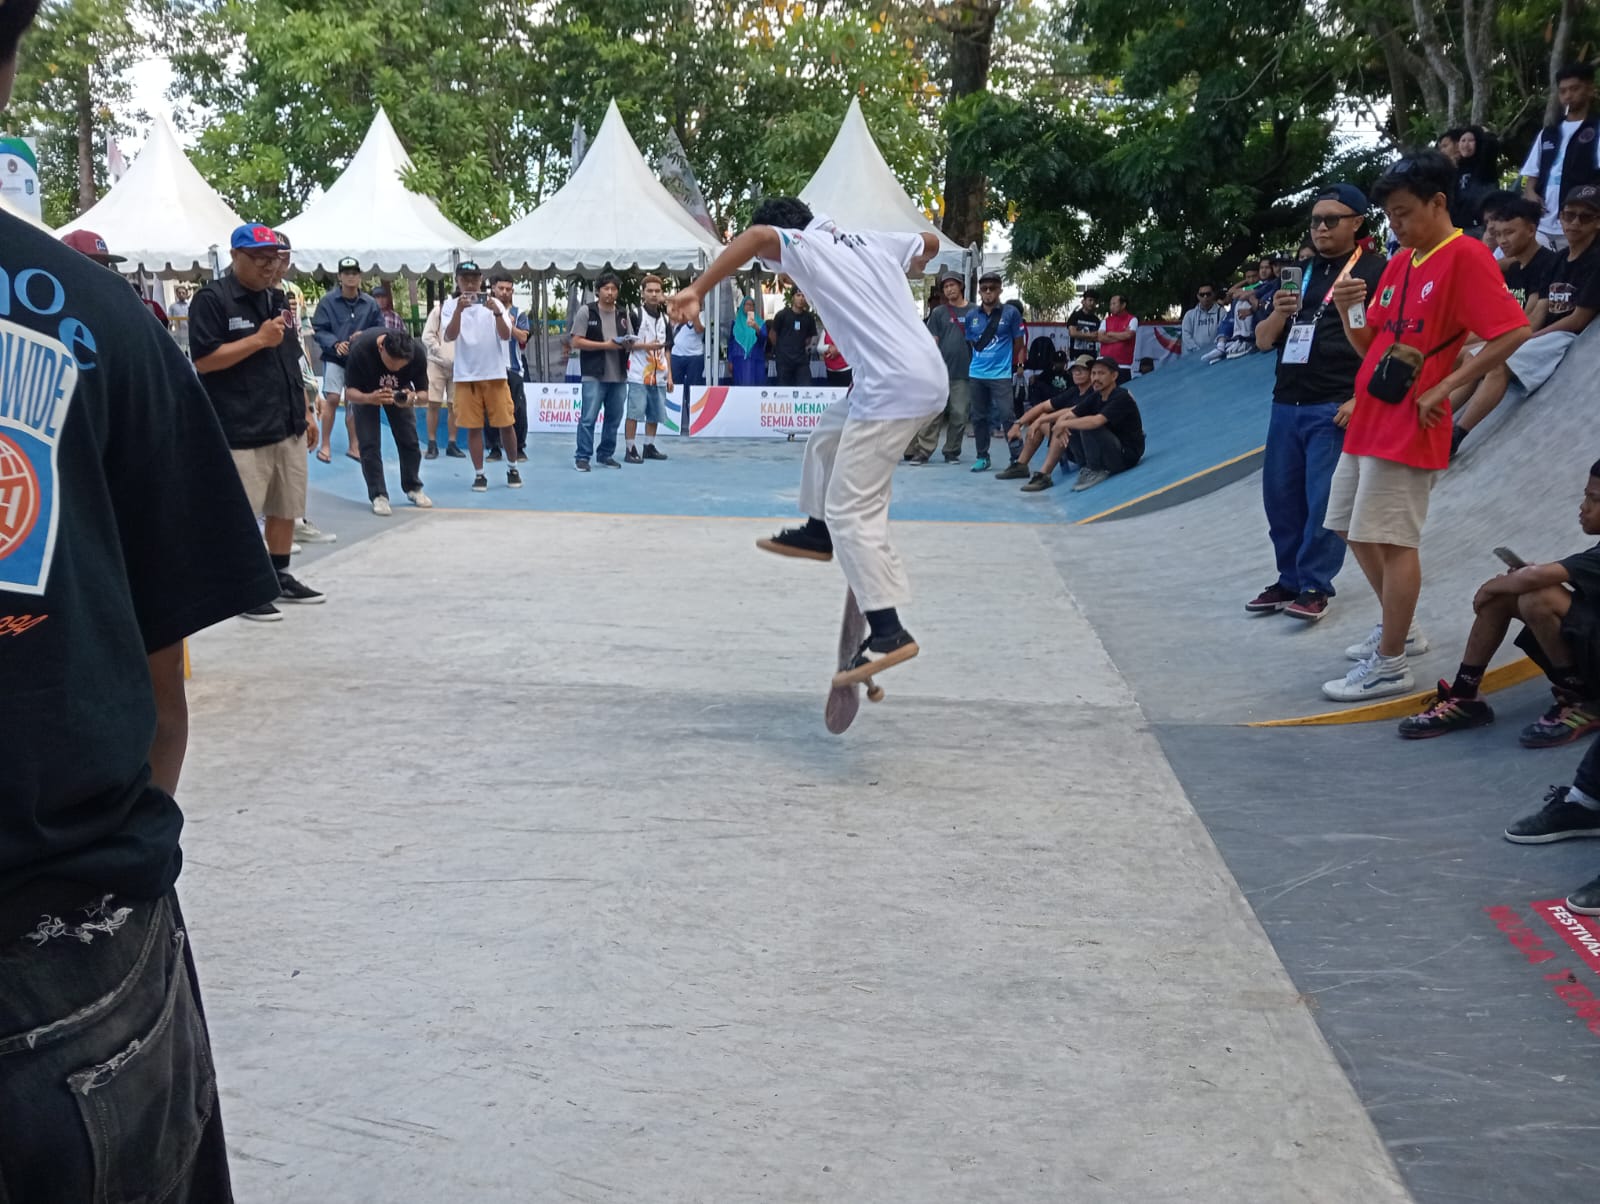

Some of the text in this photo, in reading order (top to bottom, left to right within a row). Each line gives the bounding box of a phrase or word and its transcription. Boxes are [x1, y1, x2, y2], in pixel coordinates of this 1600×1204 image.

[540, 400, 571, 410] KALAH
[760, 402, 792, 414] KALAH
[539, 411, 572, 422] SEMUA
[760, 415, 794, 427] SEMUA
[1547, 904, 1600, 957] FESTIVAL
